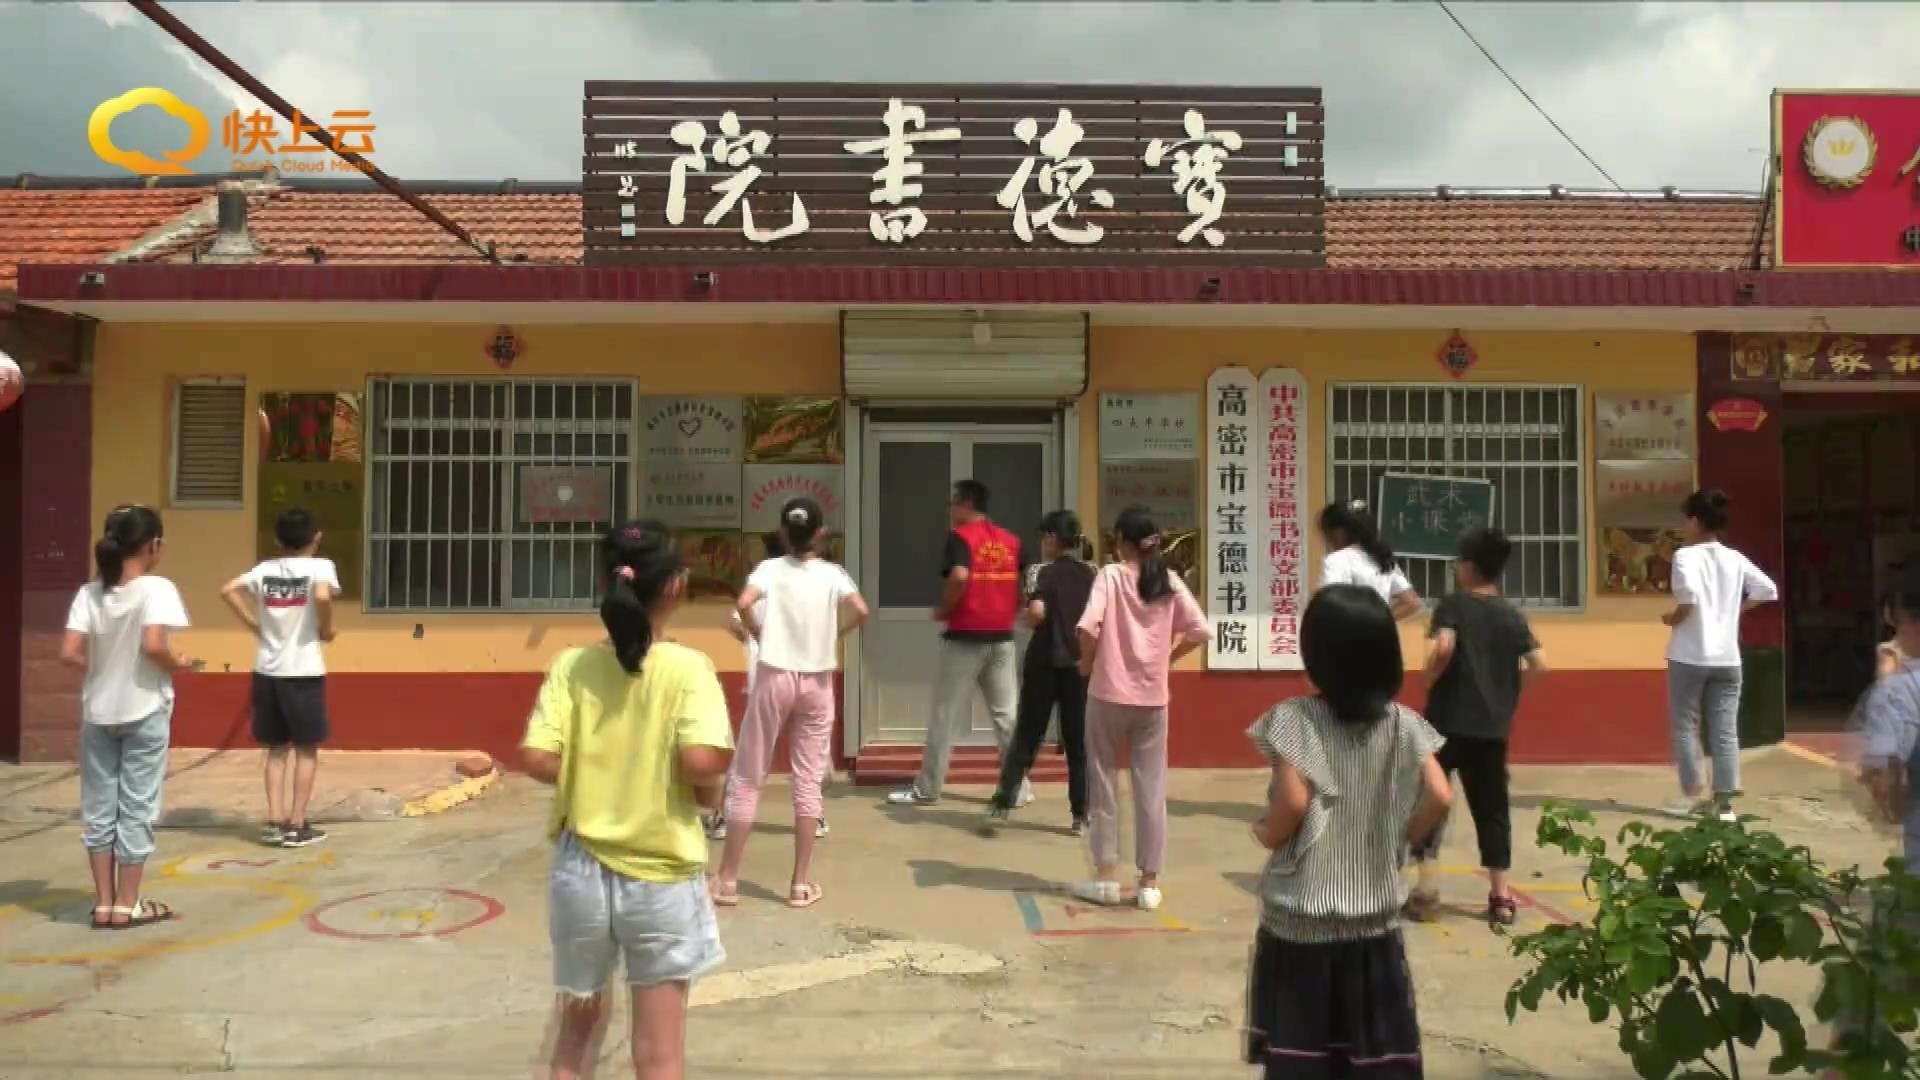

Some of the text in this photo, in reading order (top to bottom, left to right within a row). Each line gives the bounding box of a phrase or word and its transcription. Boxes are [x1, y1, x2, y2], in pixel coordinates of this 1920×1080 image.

[1446, 344, 1469, 369] 福
[1216, 384, 1248, 655] 高密市宝德书院
[1268, 384, 1300, 655] 中共高密市宝德书院支部委员会
